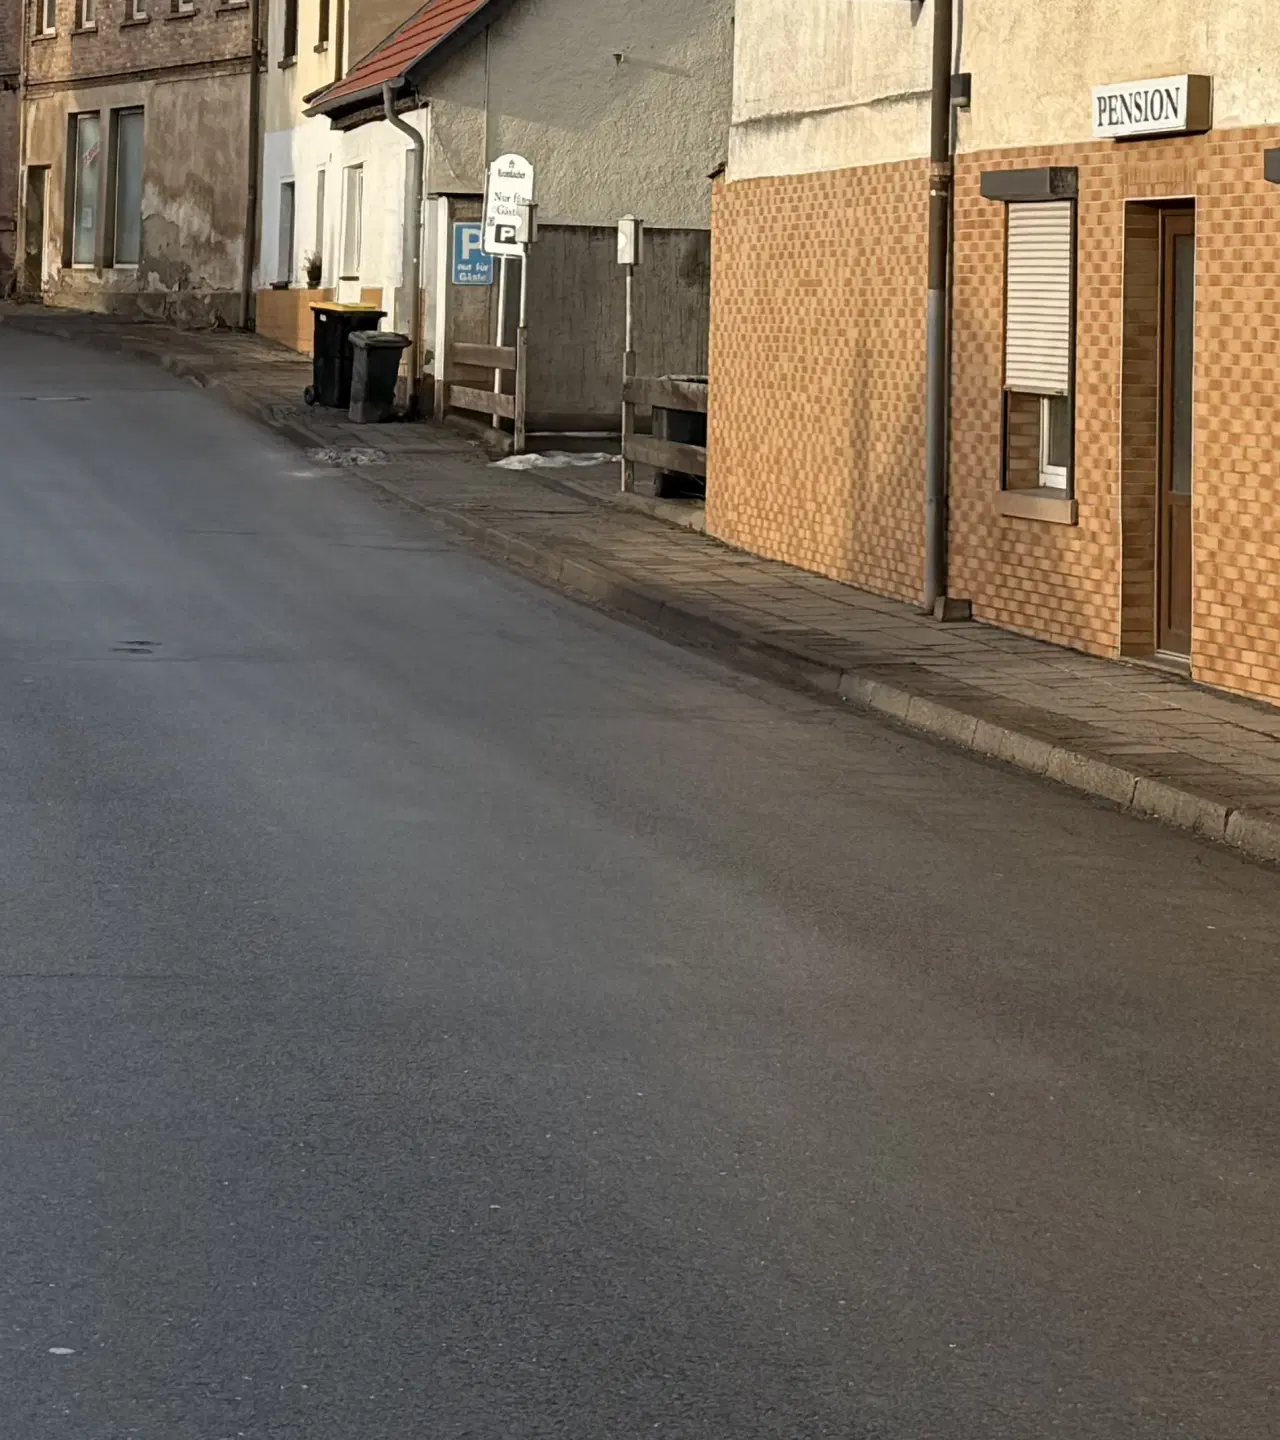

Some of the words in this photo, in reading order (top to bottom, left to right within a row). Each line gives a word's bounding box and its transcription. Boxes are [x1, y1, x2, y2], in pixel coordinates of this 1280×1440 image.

[1096, 87, 1180, 127] PENSION
[494, 191, 511, 202] Nur
[462, 228, 481, 260] P
[501, 227, 515, 241] P
